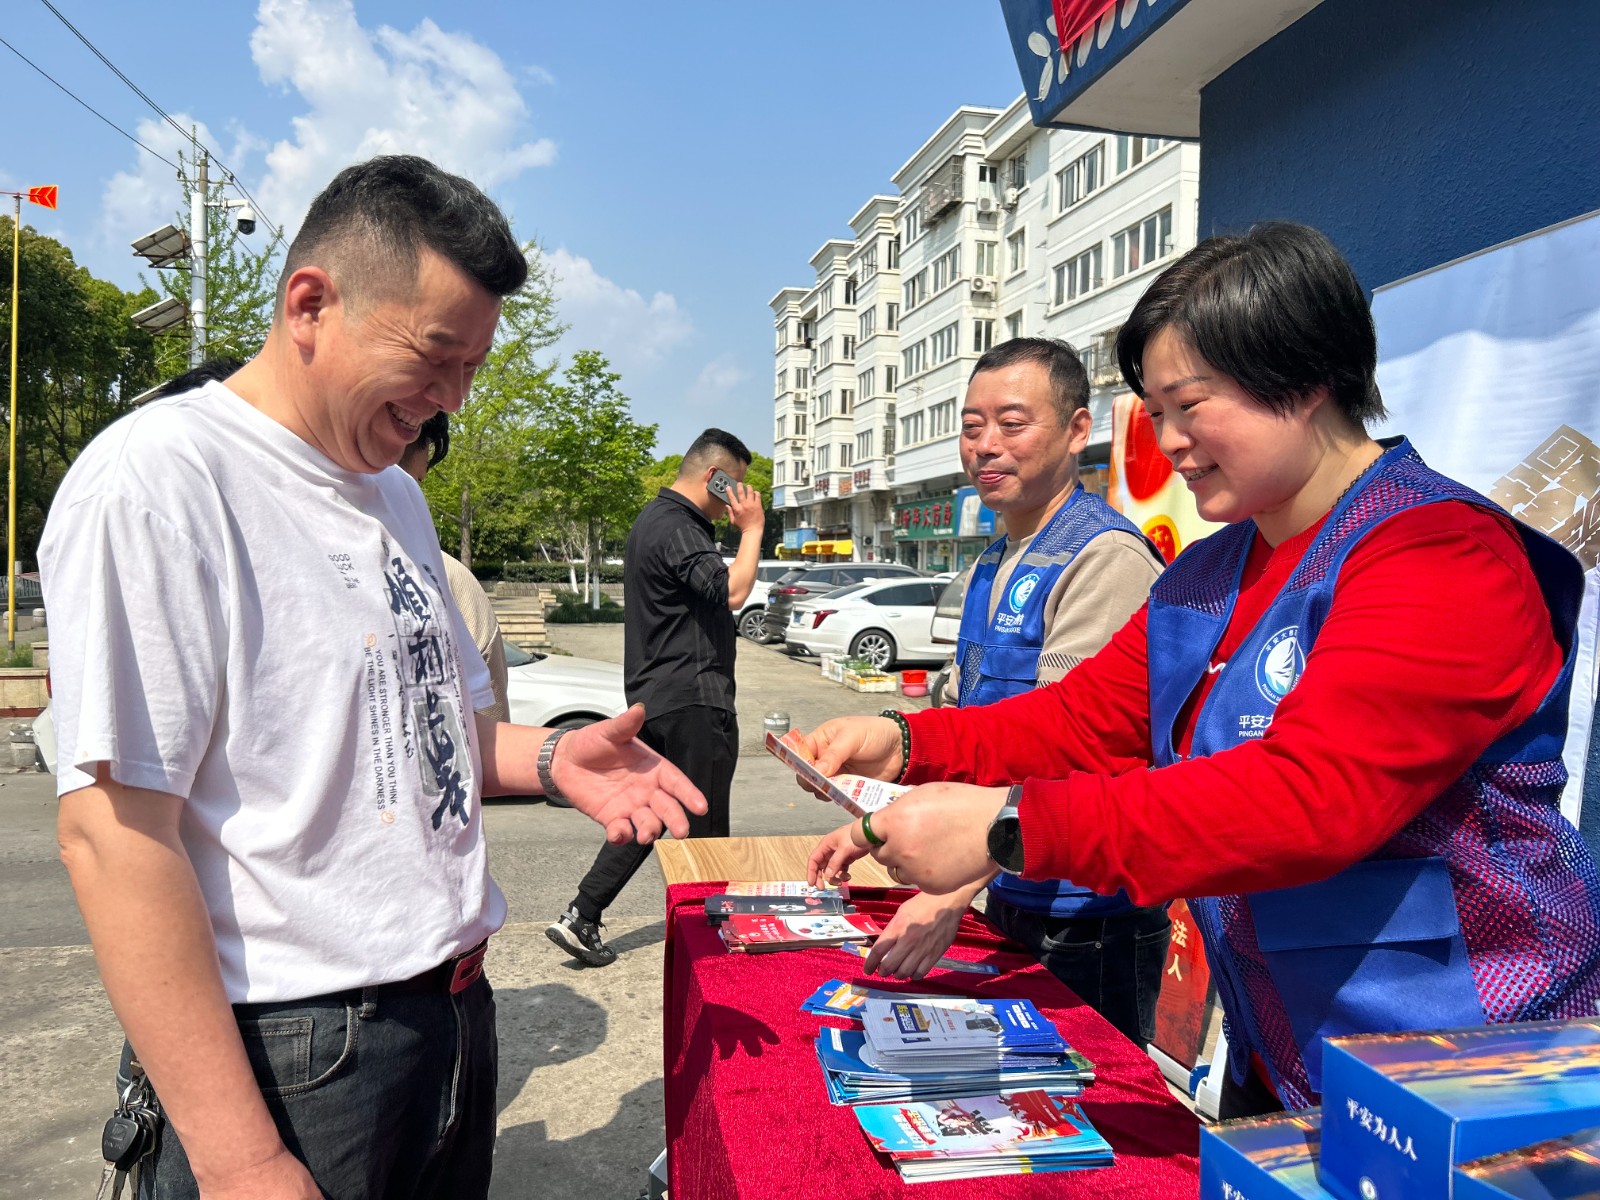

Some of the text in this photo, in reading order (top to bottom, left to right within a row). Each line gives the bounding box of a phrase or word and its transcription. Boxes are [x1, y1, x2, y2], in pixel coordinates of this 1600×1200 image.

[328, 553, 351, 562] GOOD
[363, 646, 386, 810] BE THE LIGHT SHINES IN THE DARKNESS
[375, 649, 398, 805] YOU ARE STRONGER THAN YOU THINK
[1347, 1097, 1418, 1162] 平安为人人
